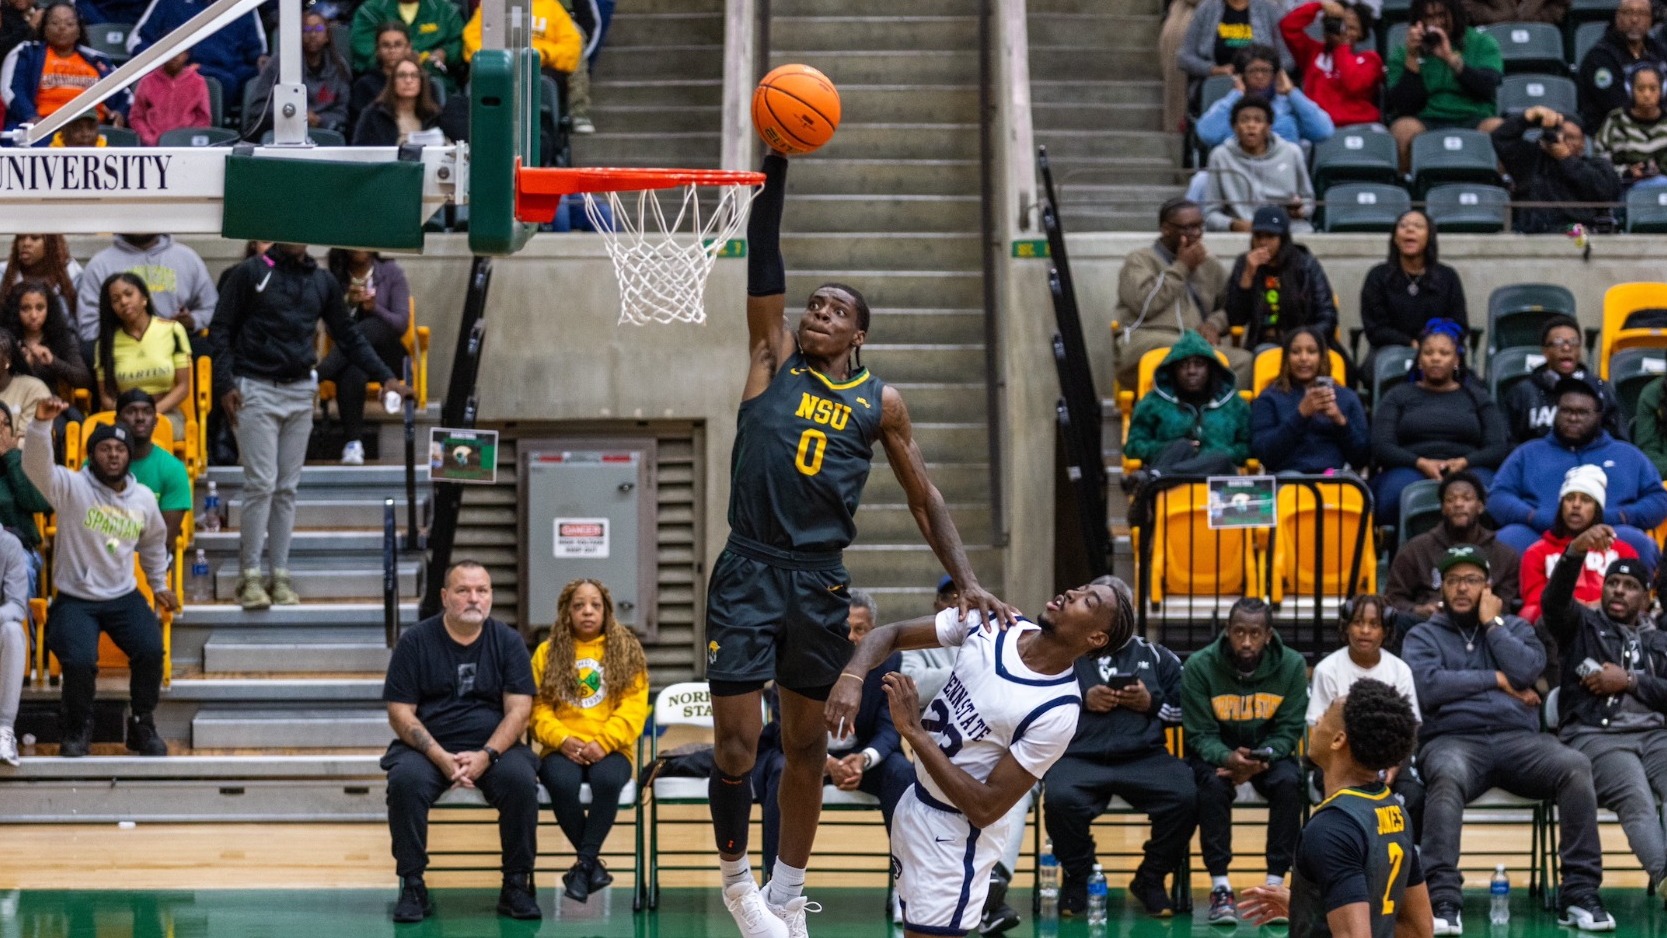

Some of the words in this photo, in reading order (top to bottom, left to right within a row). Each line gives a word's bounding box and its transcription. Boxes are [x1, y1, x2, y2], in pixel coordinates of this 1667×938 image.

[0, 154, 173, 191] NIVERSITY
[795, 391, 852, 431] NSU
[795, 428, 828, 476] 0
[1381, 841, 1404, 916] 2
